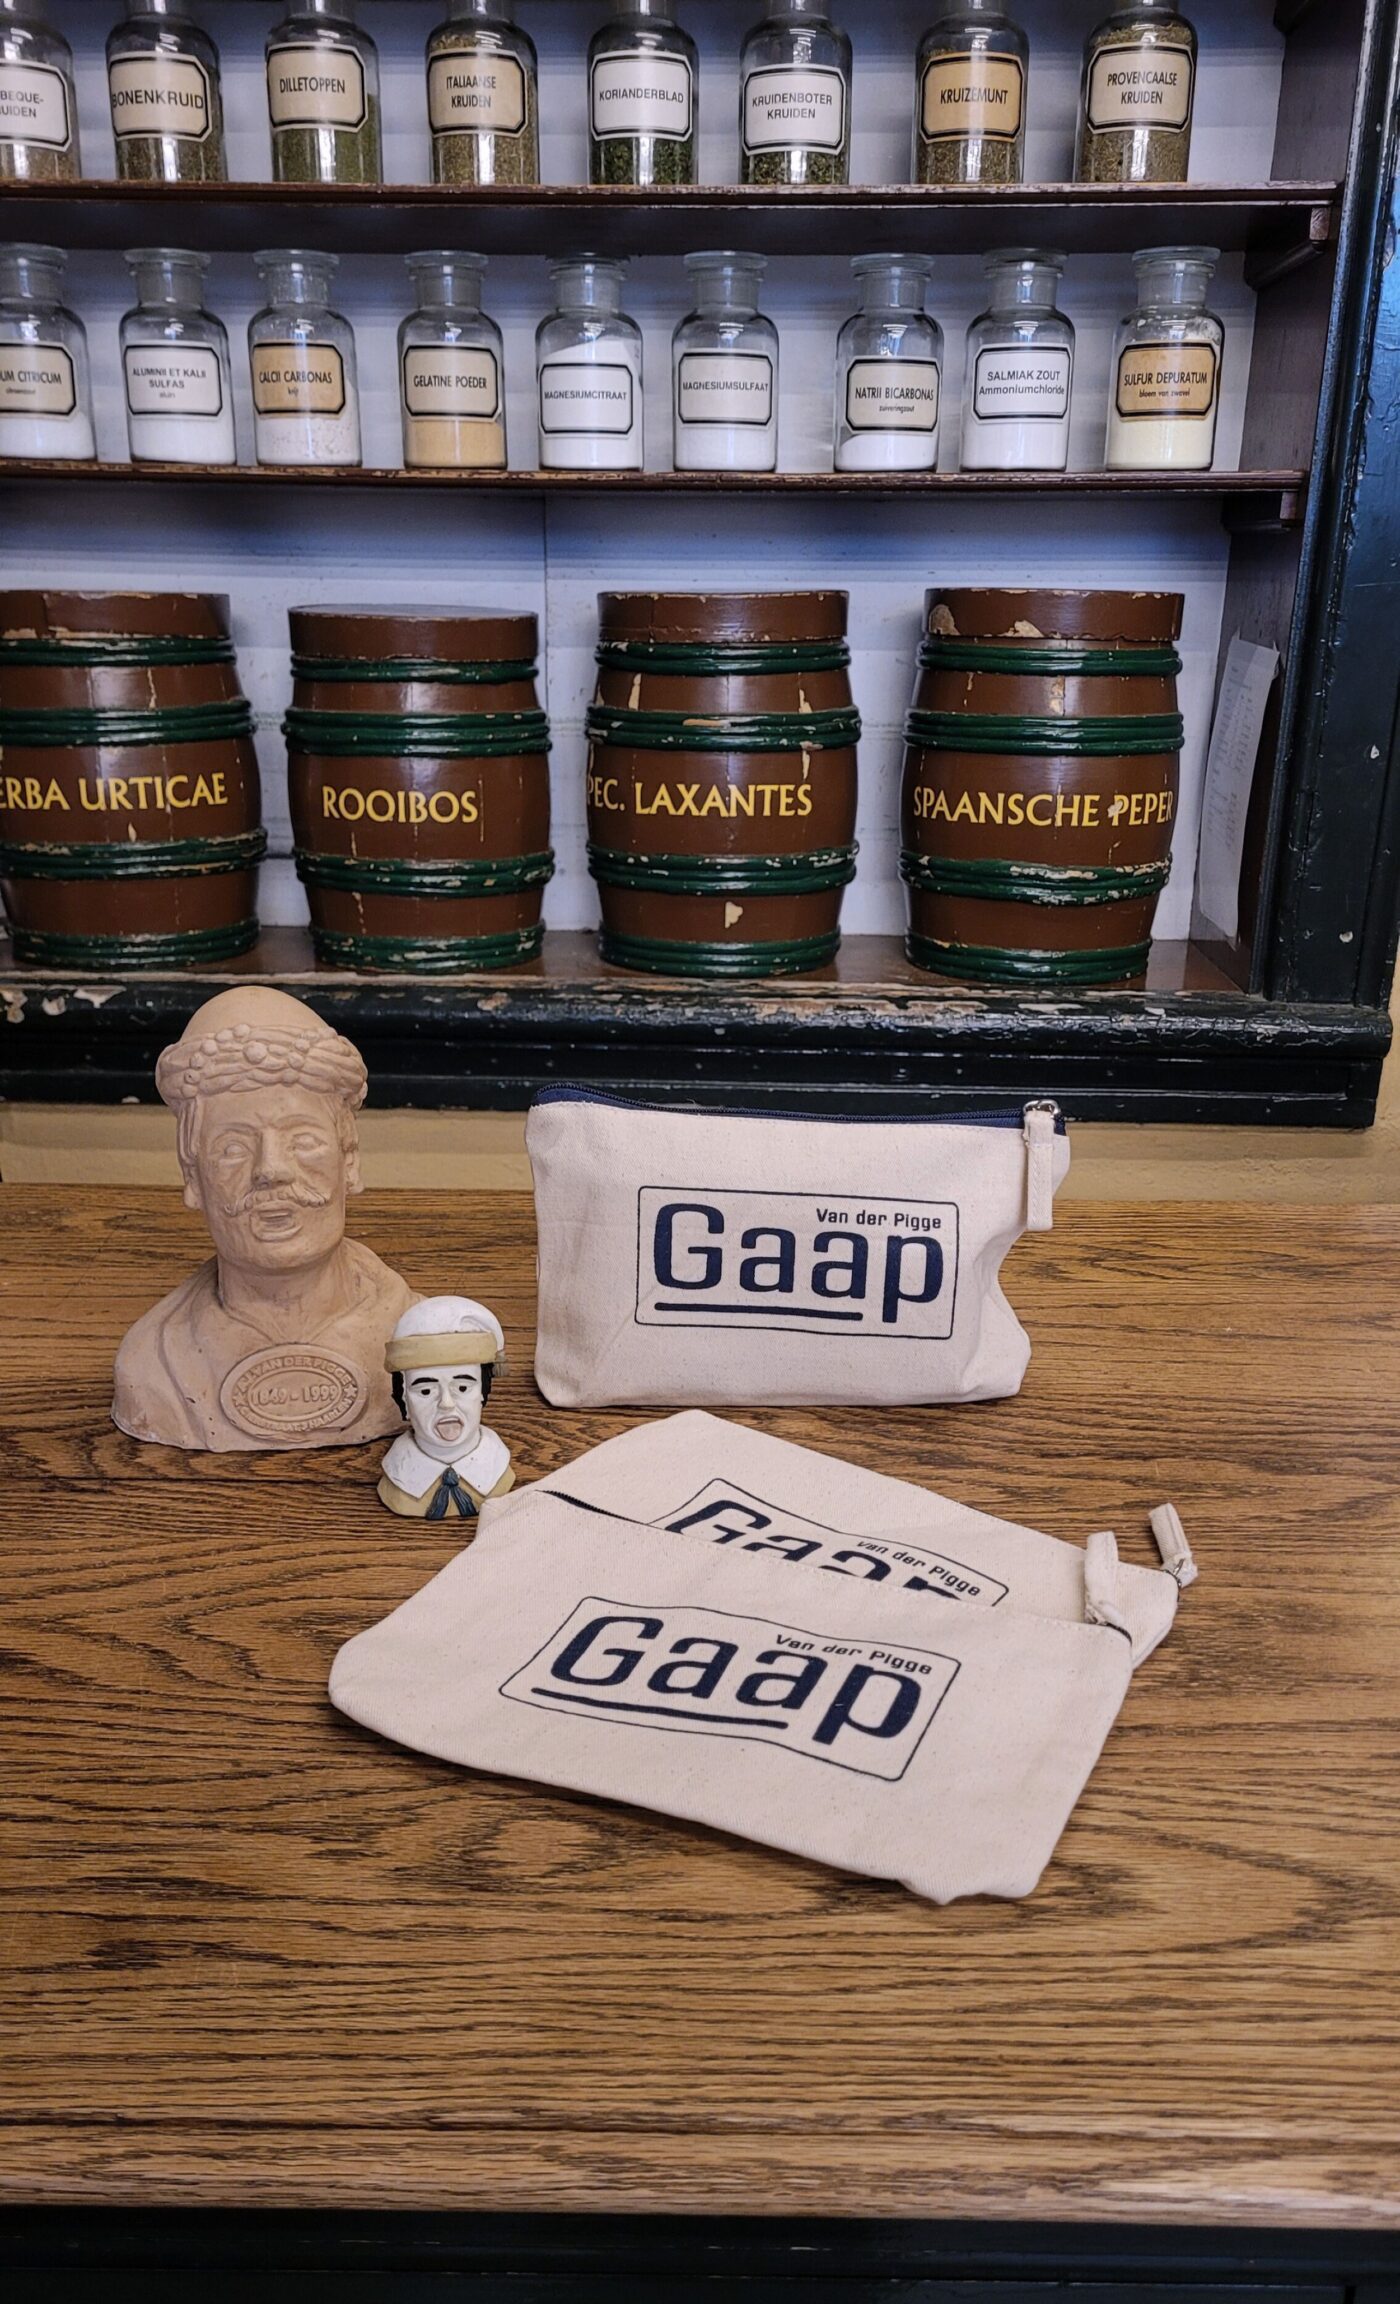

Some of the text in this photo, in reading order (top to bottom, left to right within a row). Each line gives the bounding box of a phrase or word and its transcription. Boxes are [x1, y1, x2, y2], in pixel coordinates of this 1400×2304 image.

[279, 76, 346, 94] DILLETOPPEN
[446, 75, 497, 90] ITALIAANSE
[1106, 71, 1178, 87] PROVENCAALSE
[111, 89, 204, 110] BONENKRUID
[451, 94, 492, 109] KRUIDEN
[599, 88, 684, 103] KORIANDERBLAD
[752, 92, 833, 107] KRUIDENBOTER
[940, 87, 1009, 105] KRUIZEMUNT
[1120, 91, 1164, 105] KRUIDEN
[0, 105, 36, 118] UIDEN
[767, 108, 816, 120] KRUIDEN
[169, 368, 181, 377] ET
[283, 370, 333, 384] CARBONAS
[987, 370, 1061, 382] SALMIAK ZOUT
[1123, 371, 1208, 386] SULFUR DEPURATUM
[149, 379, 185, 389] SULFAS
[413, 375, 488, 389] GELATINE POEDER
[682, 381, 769, 393] MAGNESIUMSULFAAT
[978, 383, 1065, 396] Ammoniumchloride
[544, 389, 627, 400] MAGNESIUMCITRAAT
[855, 387, 934, 400] NATRII BICARBONAS
[79, 773, 228, 811] URTICAE
[322, 786, 478, 823] ROOIBOS
[635, 782, 812, 818] LAXANTES
[913, 786, 1100, 828] SPAANSCHE
[1112, 791, 1174, 826] PEPER
[816, 1208, 942, 1232] Van der Pigge
[653, 1203, 944, 1323] Gaap
[302, 1385, 339, 1402] 1999
[892, 1549, 926, 1568] der
[928, 1565, 981, 1597] Pigge
[775, 1634, 934, 1677] Van der Pigge
[550, 1615, 922, 1745] Gaap
